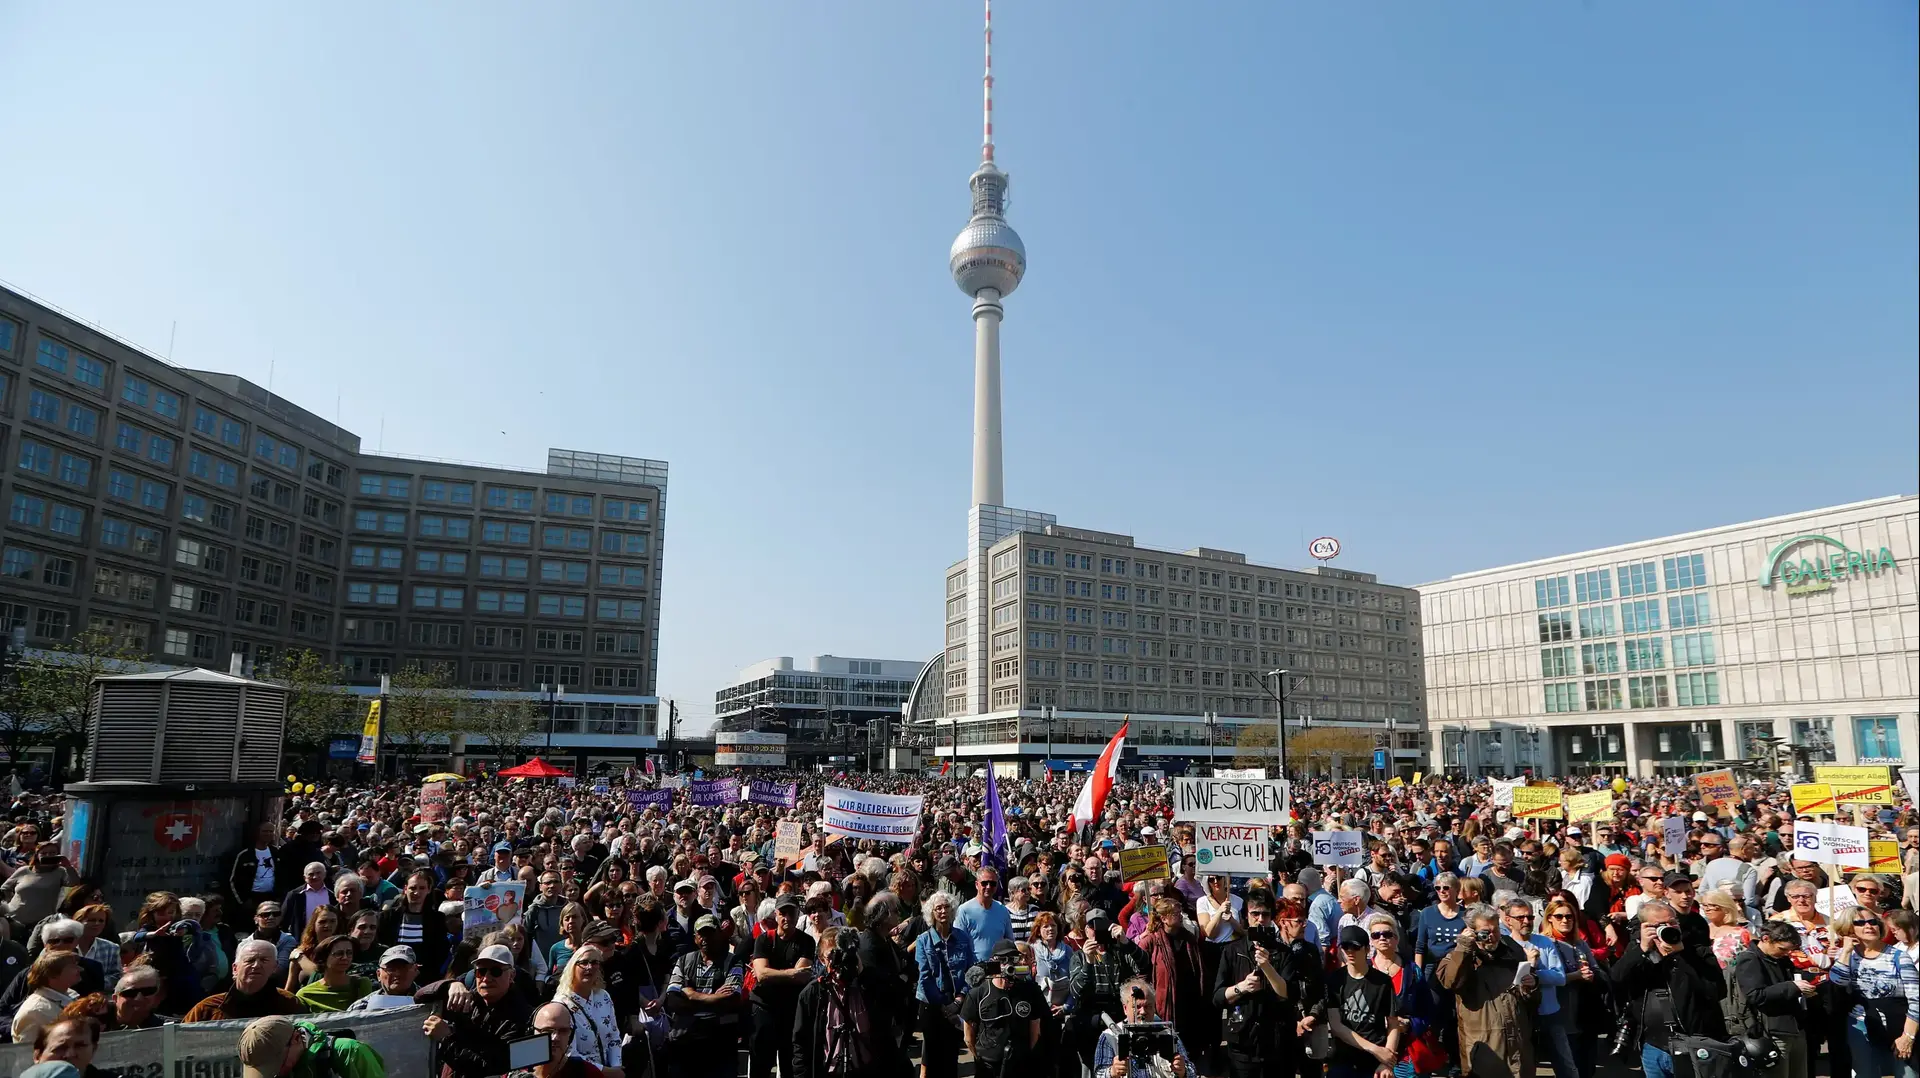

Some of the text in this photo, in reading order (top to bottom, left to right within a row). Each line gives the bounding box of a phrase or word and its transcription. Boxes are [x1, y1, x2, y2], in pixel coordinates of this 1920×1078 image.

[1314, 542, 1335, 553] C&A
[1780, 547, 1897, 583] GALERIA
[751, 780, 770, 792] KEIN
[1180, 781, 1284, 812] INVESTOREN
[1837, 789, 1882, 801] kelius
[838, 799, 855, 810] WIR
[856, 802, 892, 815] BLEIBEN
[1201, 826, 1263, 841] VERFATZT
[1822, 836, 1861, 845] DEUTSCHE
[1823, 842, 1856, 850] WOHNEN
